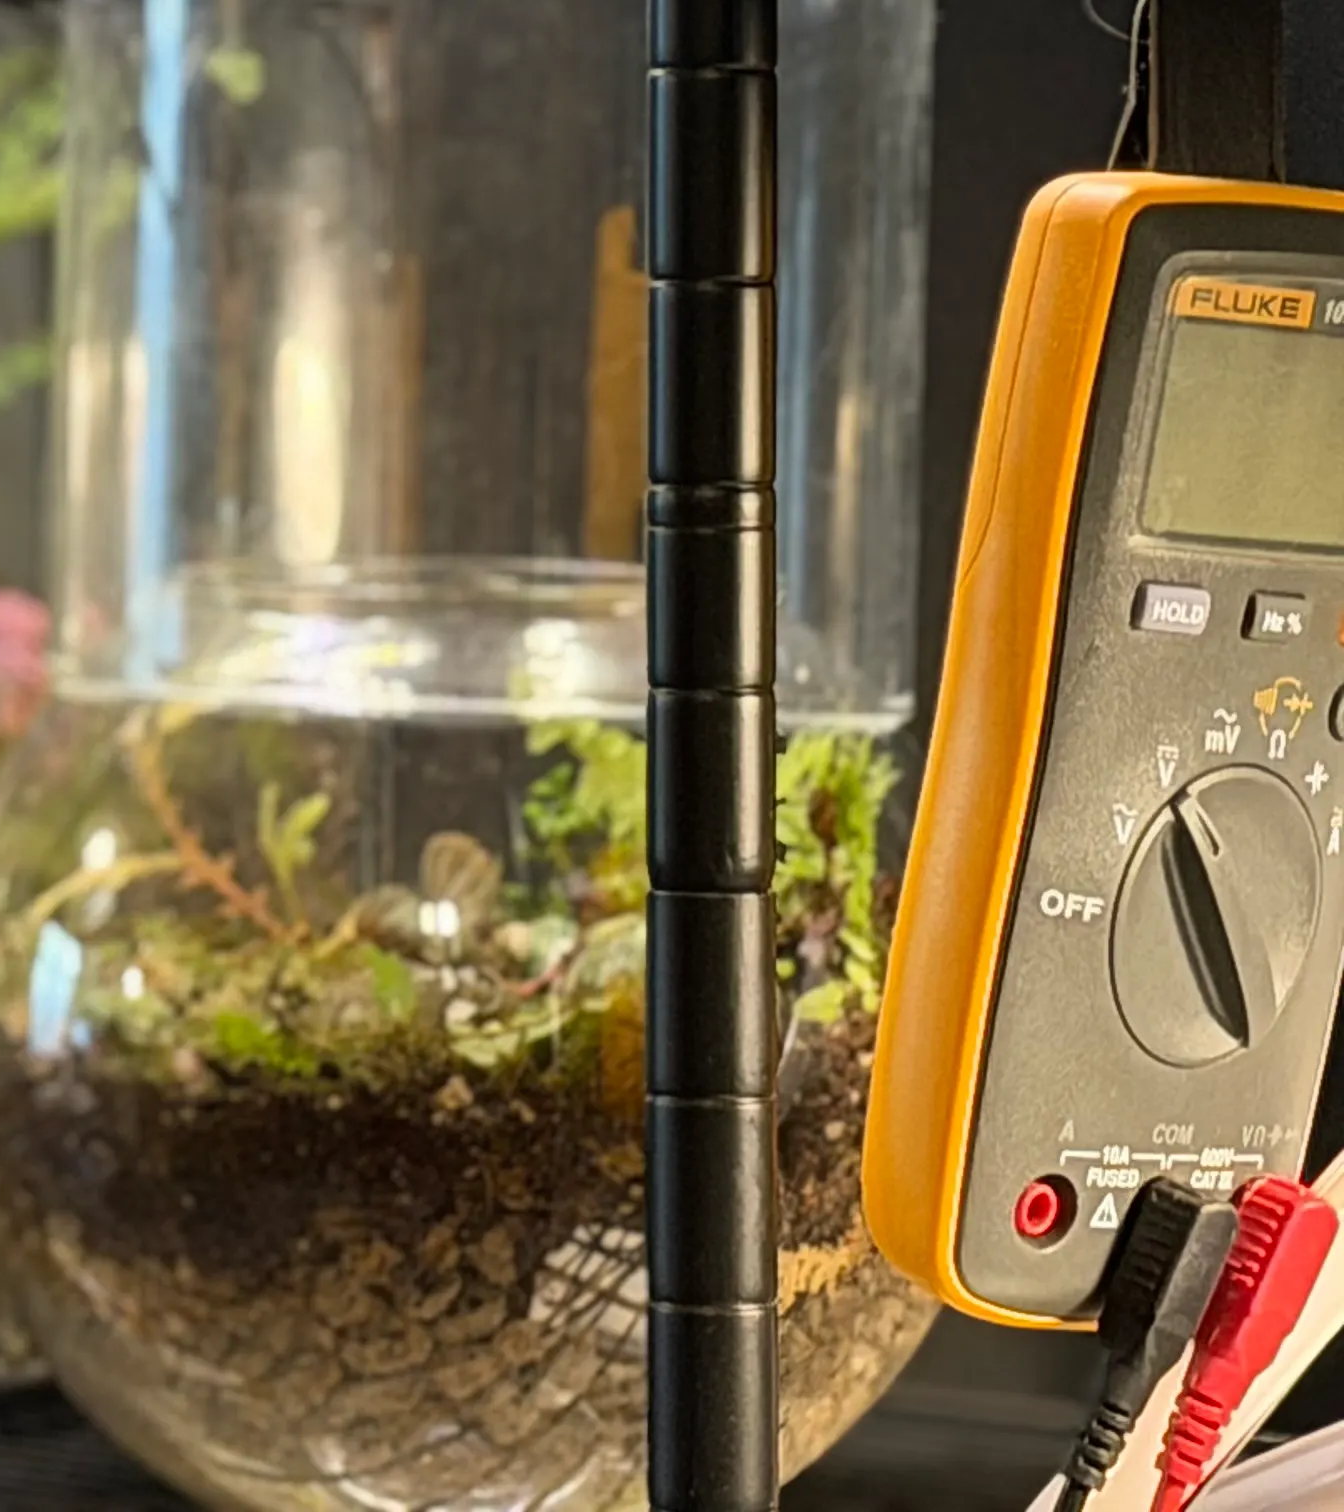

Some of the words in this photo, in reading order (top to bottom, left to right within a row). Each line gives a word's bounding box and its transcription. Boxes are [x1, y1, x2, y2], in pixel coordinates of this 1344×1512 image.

[1190, 288, 1301, 319] FLUKE
[1324, 299, 1344, 325] 10
[1153, 599, 1205, 625] HOLD
[1205, 724, 1241, 755] mV
[1040, 889, 1105, 923] OFF
[1058, 1119, 1075, 1142] A
[1153, 1123, 1195, 1146] COM
[1102, 1144, 1130, 1166] 10A
[1086, 1166, 1140, 1189] FUSED
